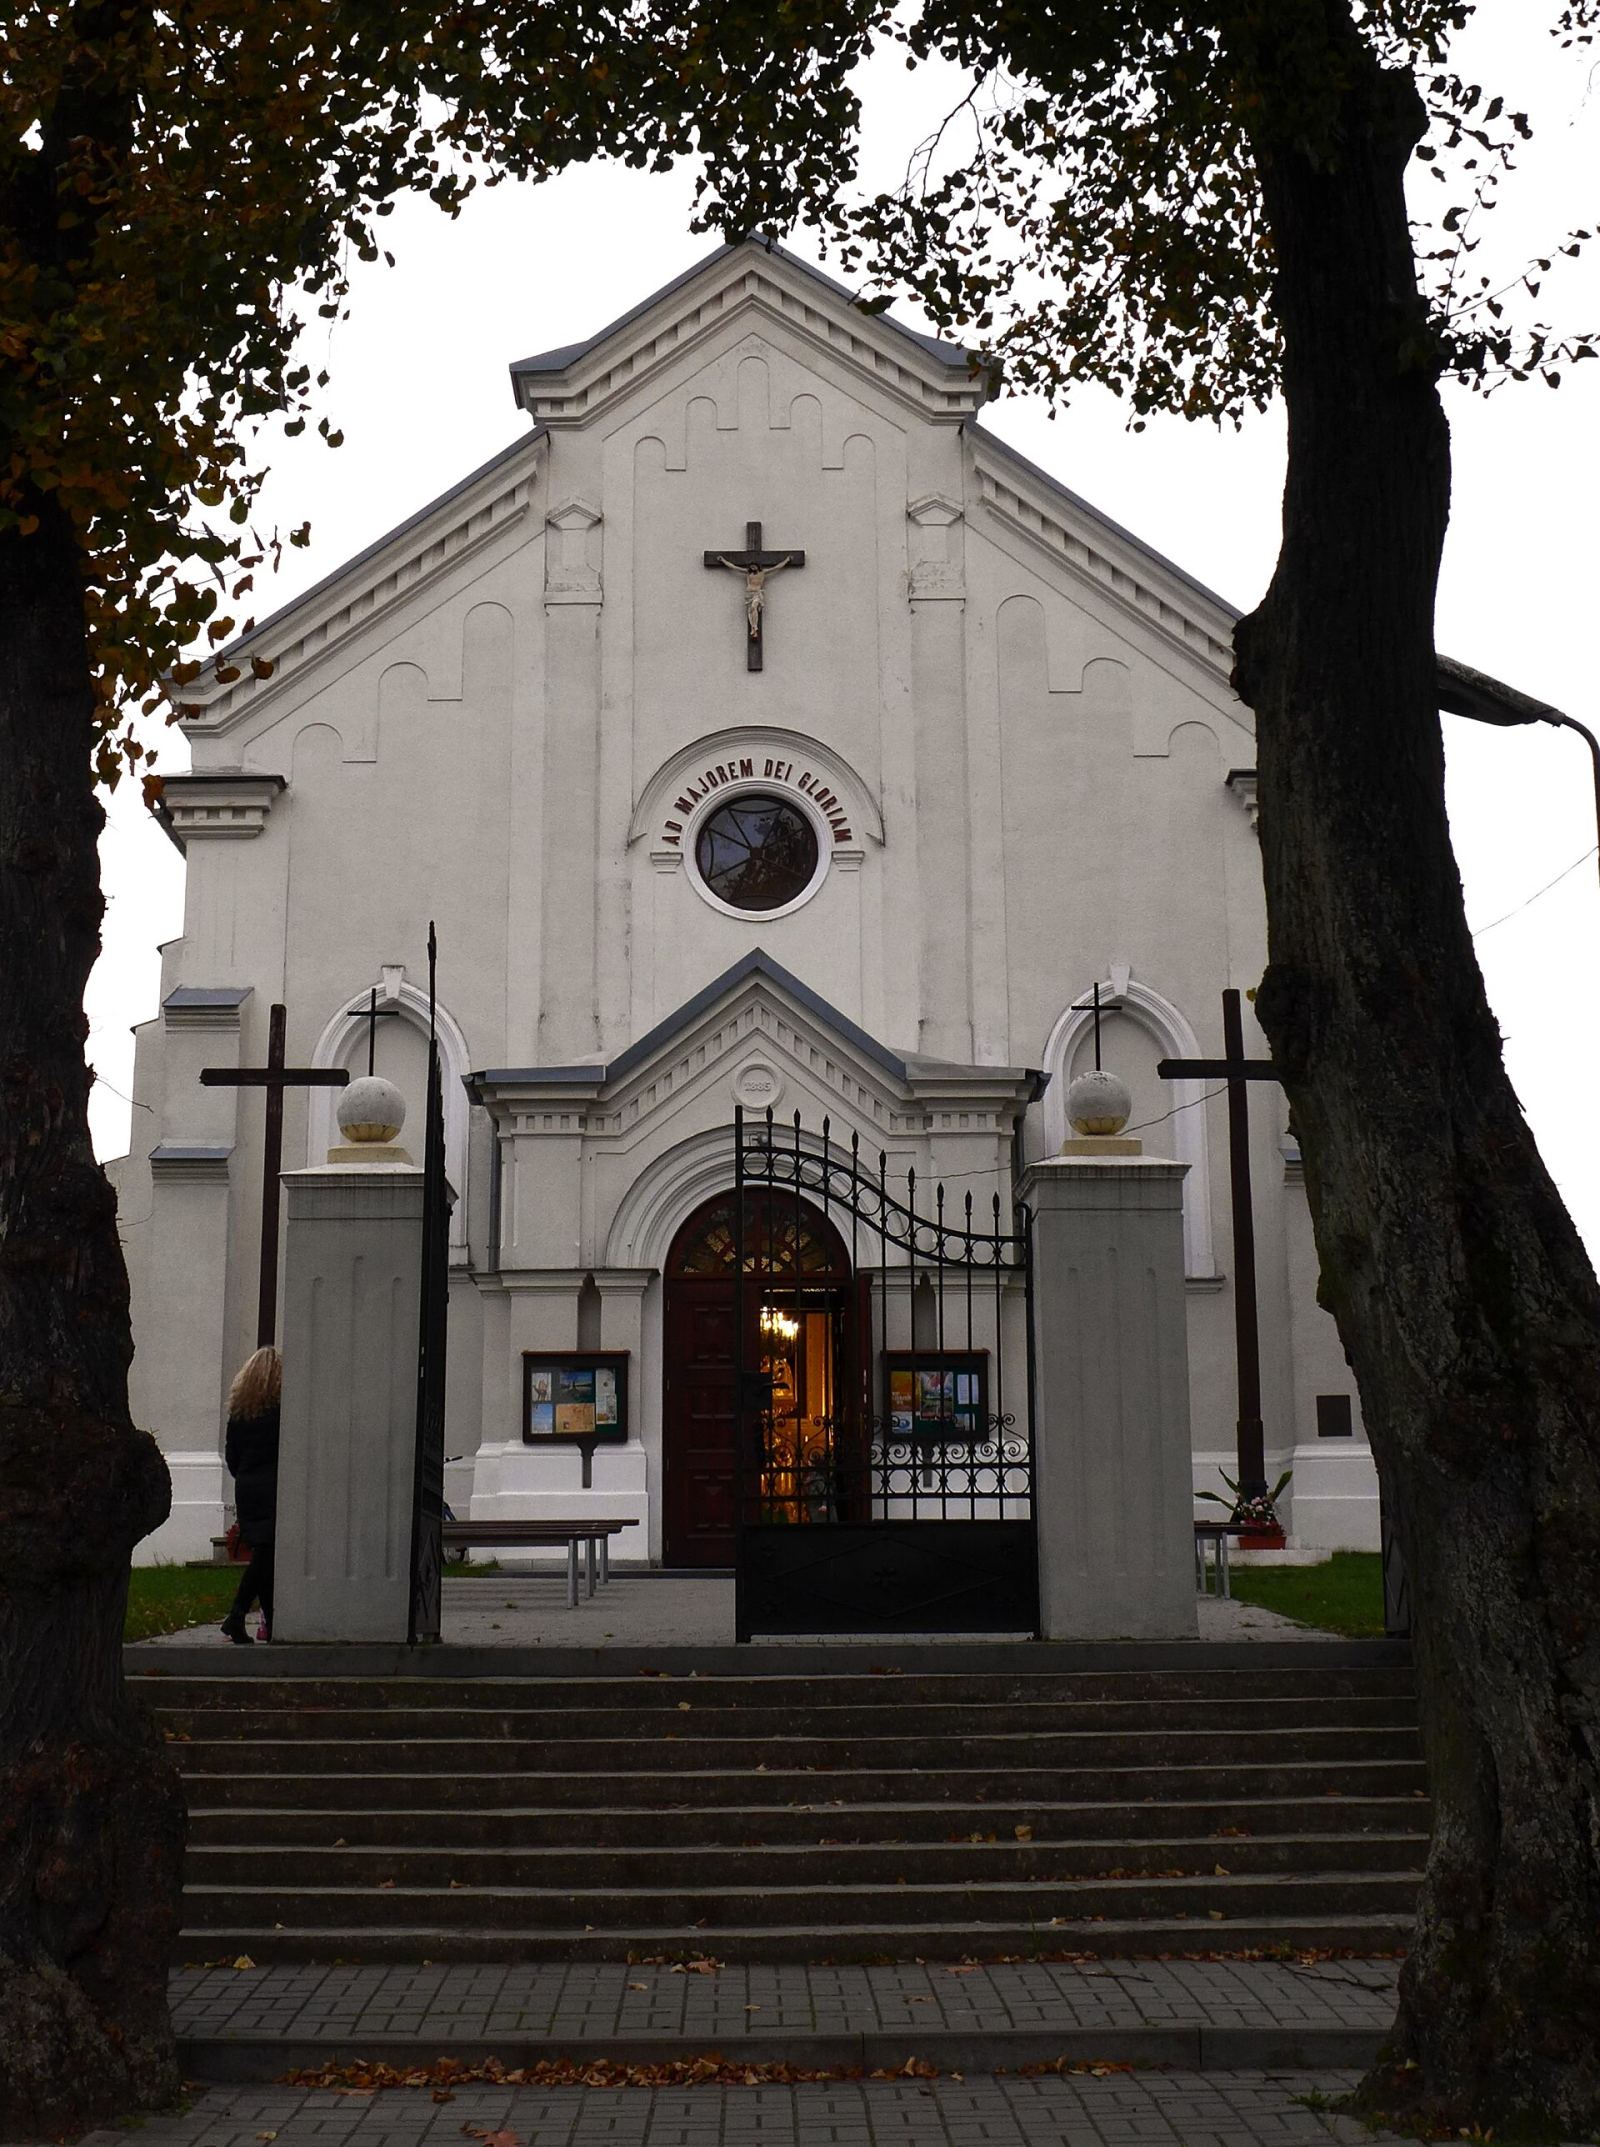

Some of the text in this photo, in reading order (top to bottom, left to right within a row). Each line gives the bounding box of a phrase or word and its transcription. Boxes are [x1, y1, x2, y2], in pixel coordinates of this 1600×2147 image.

[661, 758, 853, 847] AD MAJOREM DEI GLORIAM
